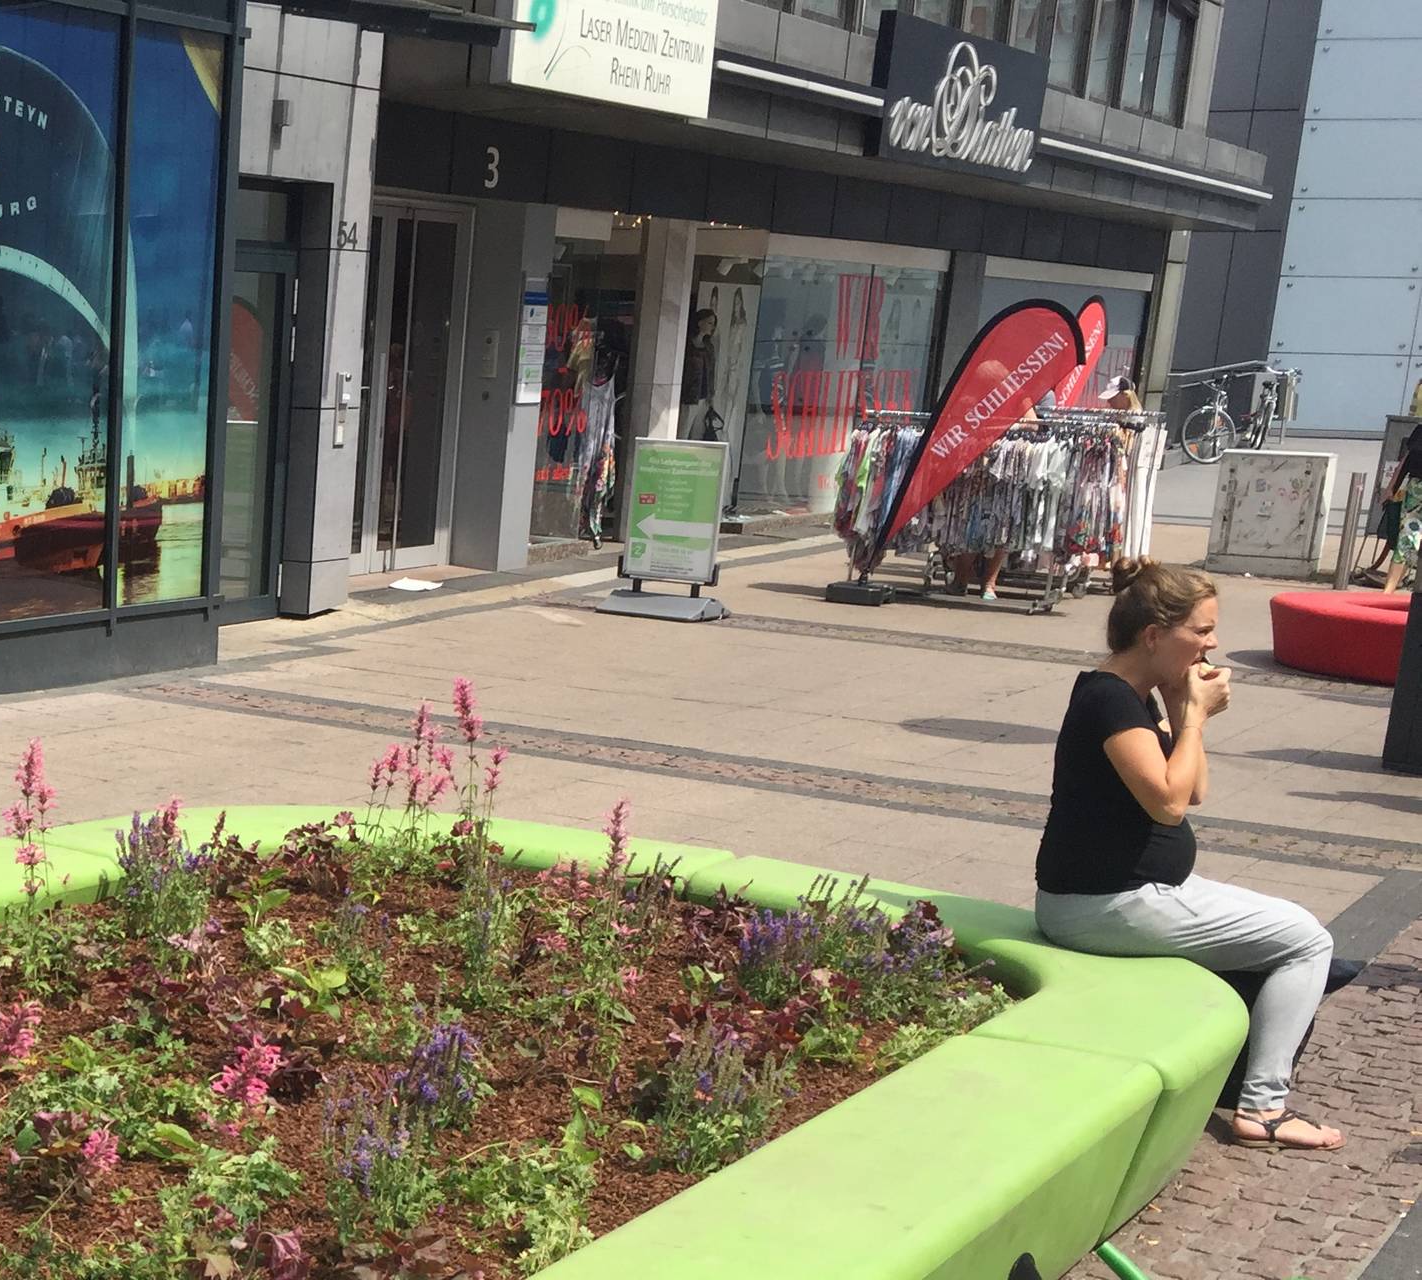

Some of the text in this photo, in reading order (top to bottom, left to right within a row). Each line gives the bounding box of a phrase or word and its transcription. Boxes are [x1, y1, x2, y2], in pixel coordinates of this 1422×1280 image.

[484, 146, 500, 189] 3
[336, 220, 358, 249] 54
[835, 272, 886, 361] WIR
[536, 388, 588, 437] 70%
[930, 423, 969, 459] WIR
[964, 331, 1069, 429] SCHLIESSEN!
